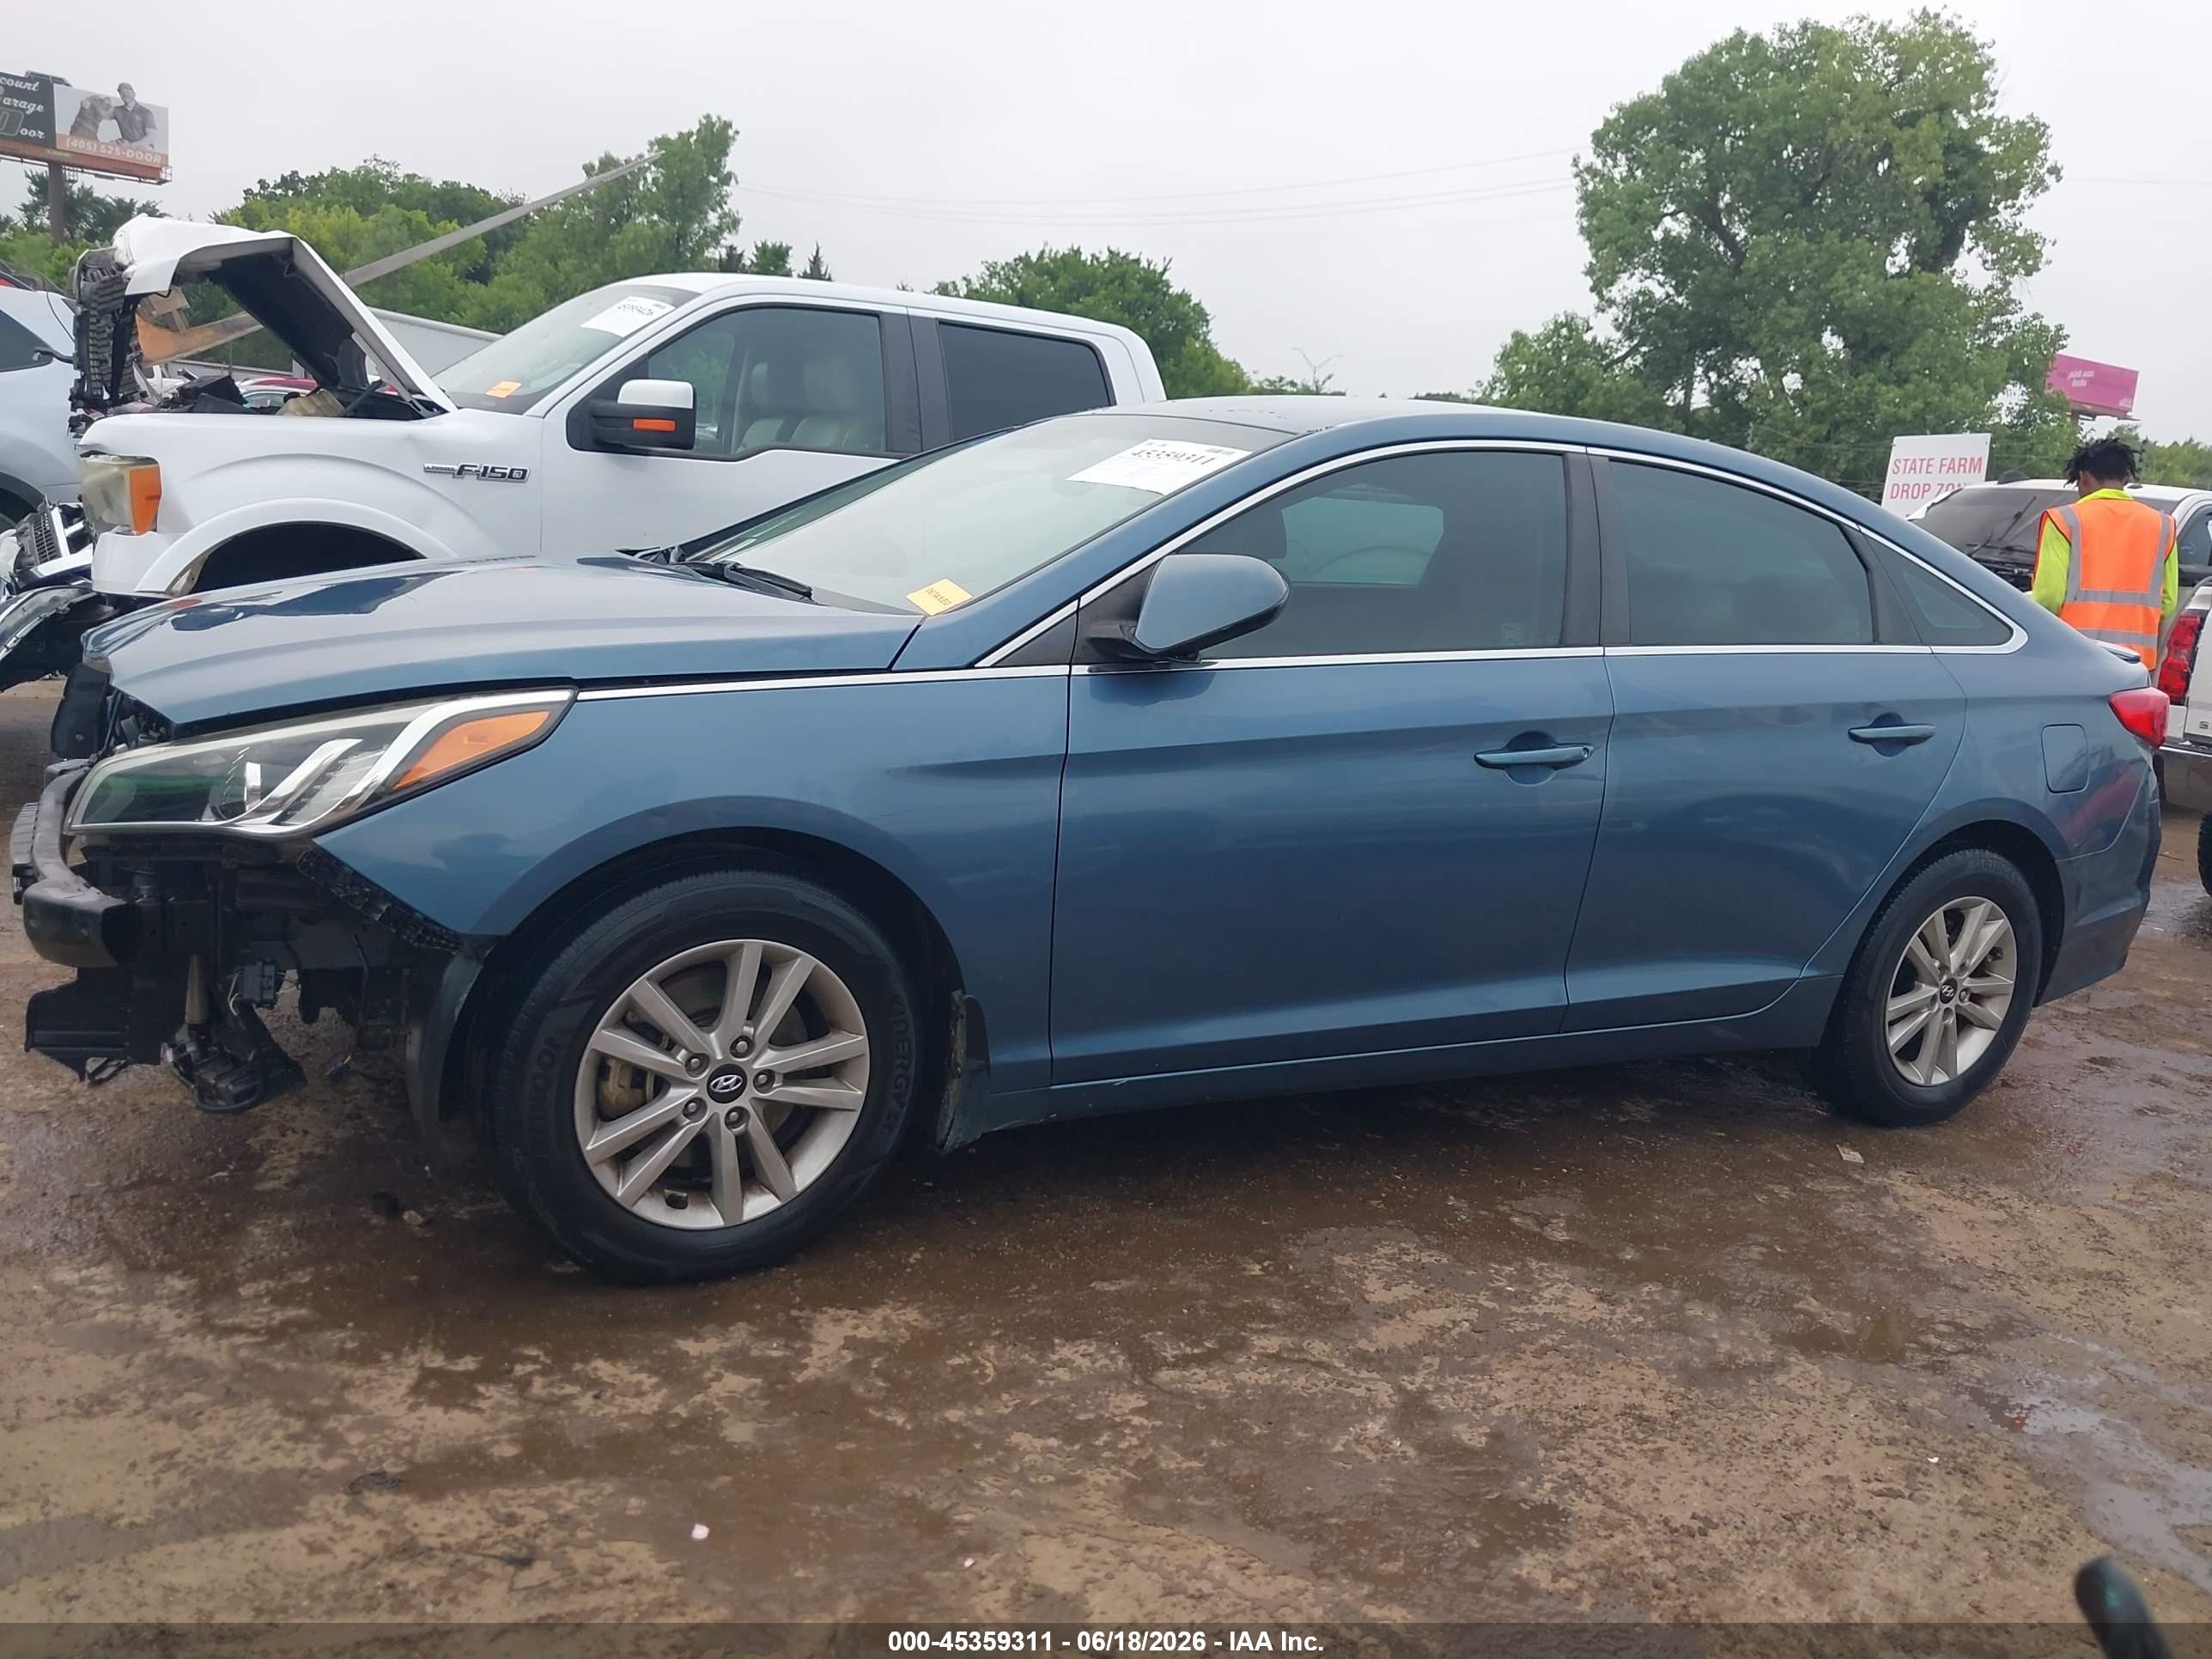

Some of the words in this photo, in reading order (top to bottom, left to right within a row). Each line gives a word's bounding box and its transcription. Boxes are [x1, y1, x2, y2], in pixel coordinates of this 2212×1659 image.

[100, 145, 162, 164] 525-DOOR
[457, 464, 528, 480] F-150
[1892, 459, 1934, 474] STATE
[1938, 457, 1983, 473] FARM
[1890, 483, 1931, 499] DROP
